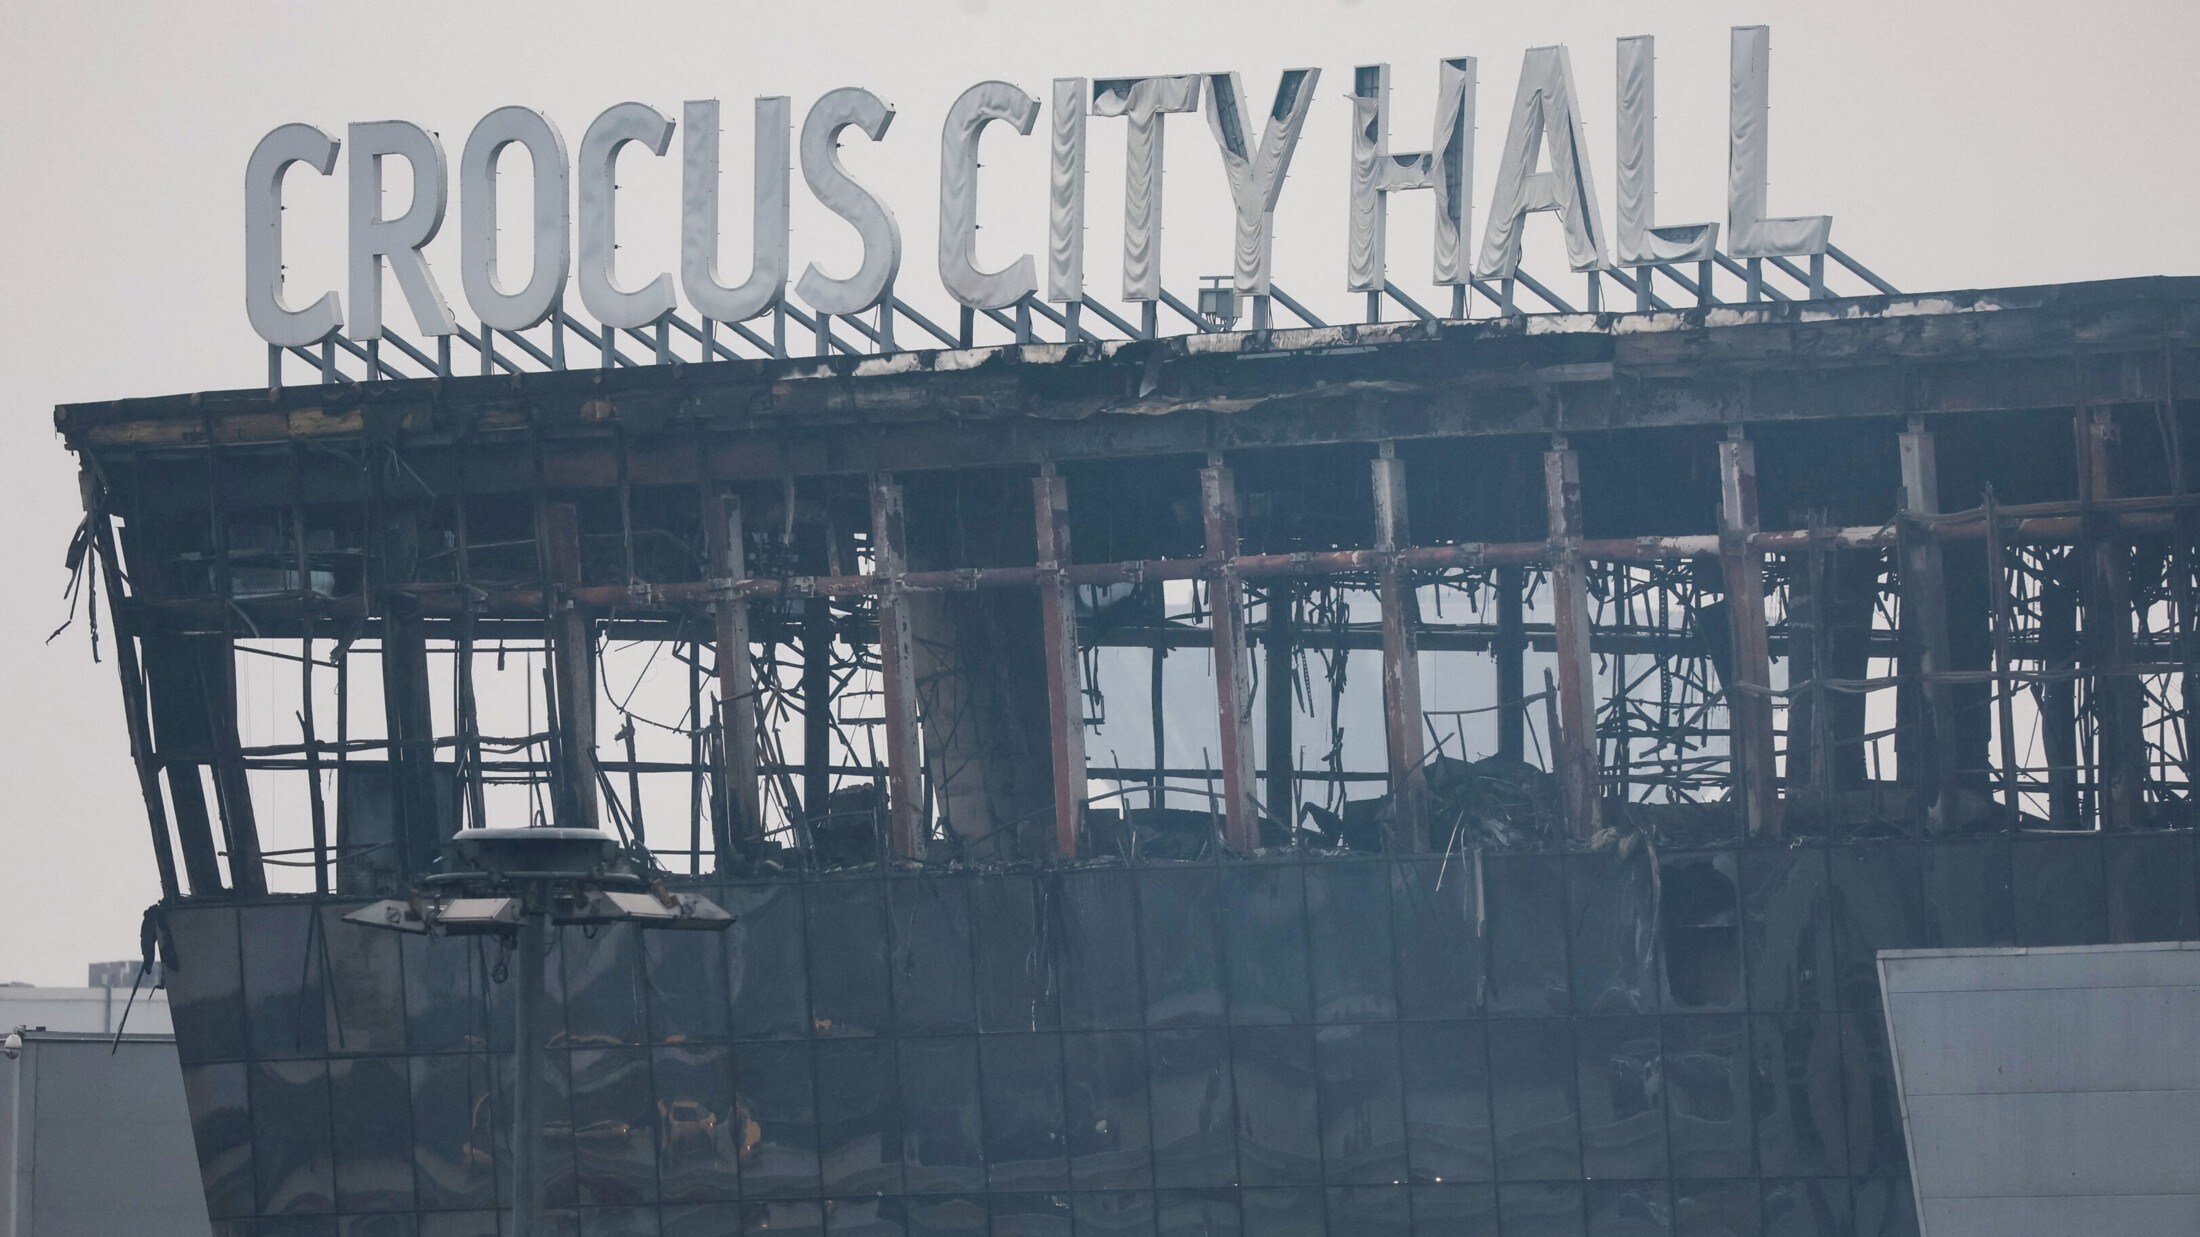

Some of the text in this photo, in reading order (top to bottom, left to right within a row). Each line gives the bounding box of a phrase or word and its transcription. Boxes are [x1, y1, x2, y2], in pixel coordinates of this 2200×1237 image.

[245, 25, 1832, 347] CROCUS CITY HALL
